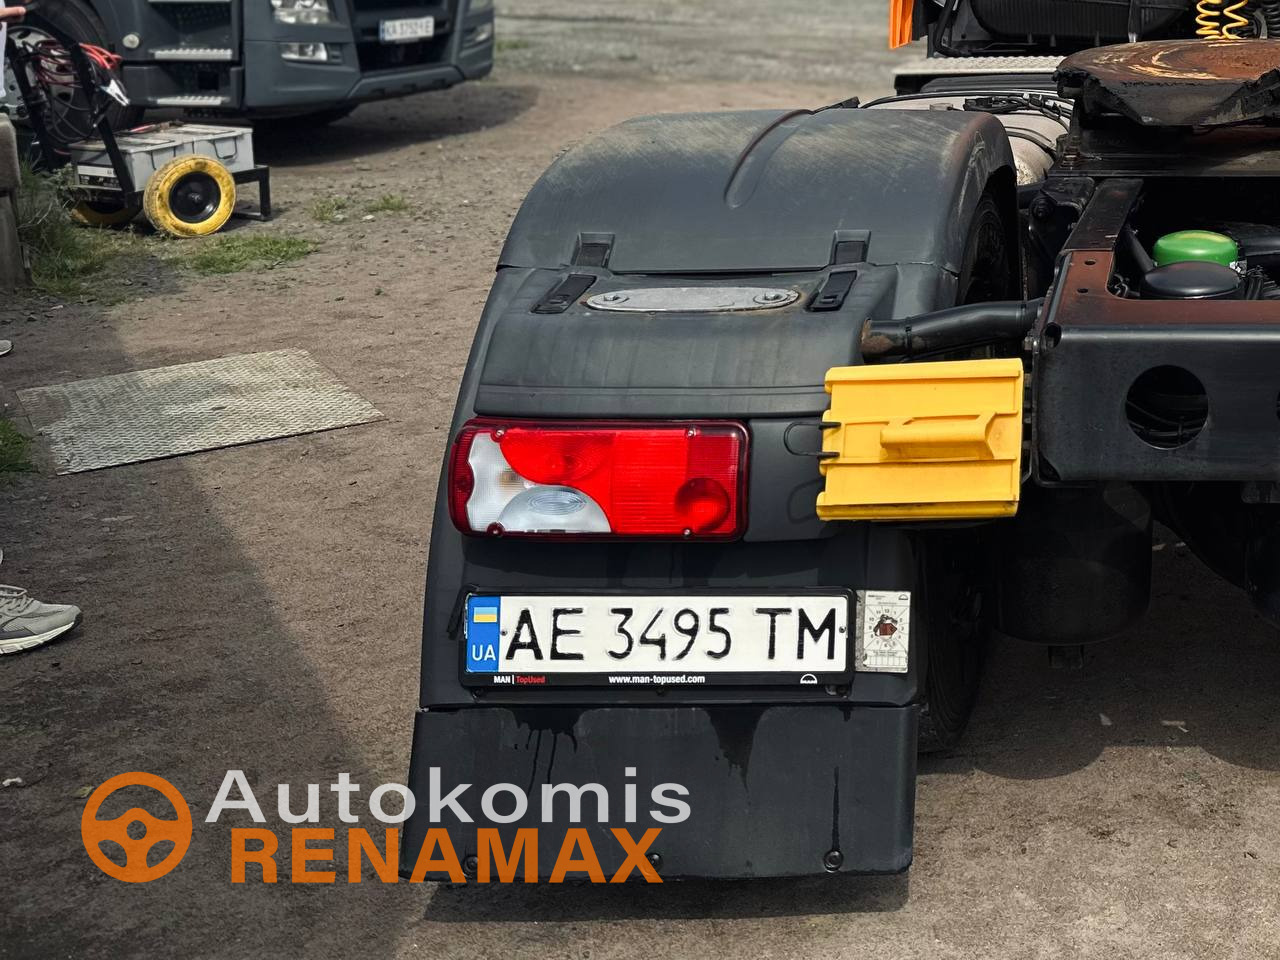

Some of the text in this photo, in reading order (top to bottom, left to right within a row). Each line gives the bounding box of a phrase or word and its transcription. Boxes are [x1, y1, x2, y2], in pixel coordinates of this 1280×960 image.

[505, 608, 836, 661] AE 3495 TM
[471, 644, 496, 661] UA
[493, 675, 546, 685] MAN TopUsed
[608, 675, 706, 685] www.man-topused.com
